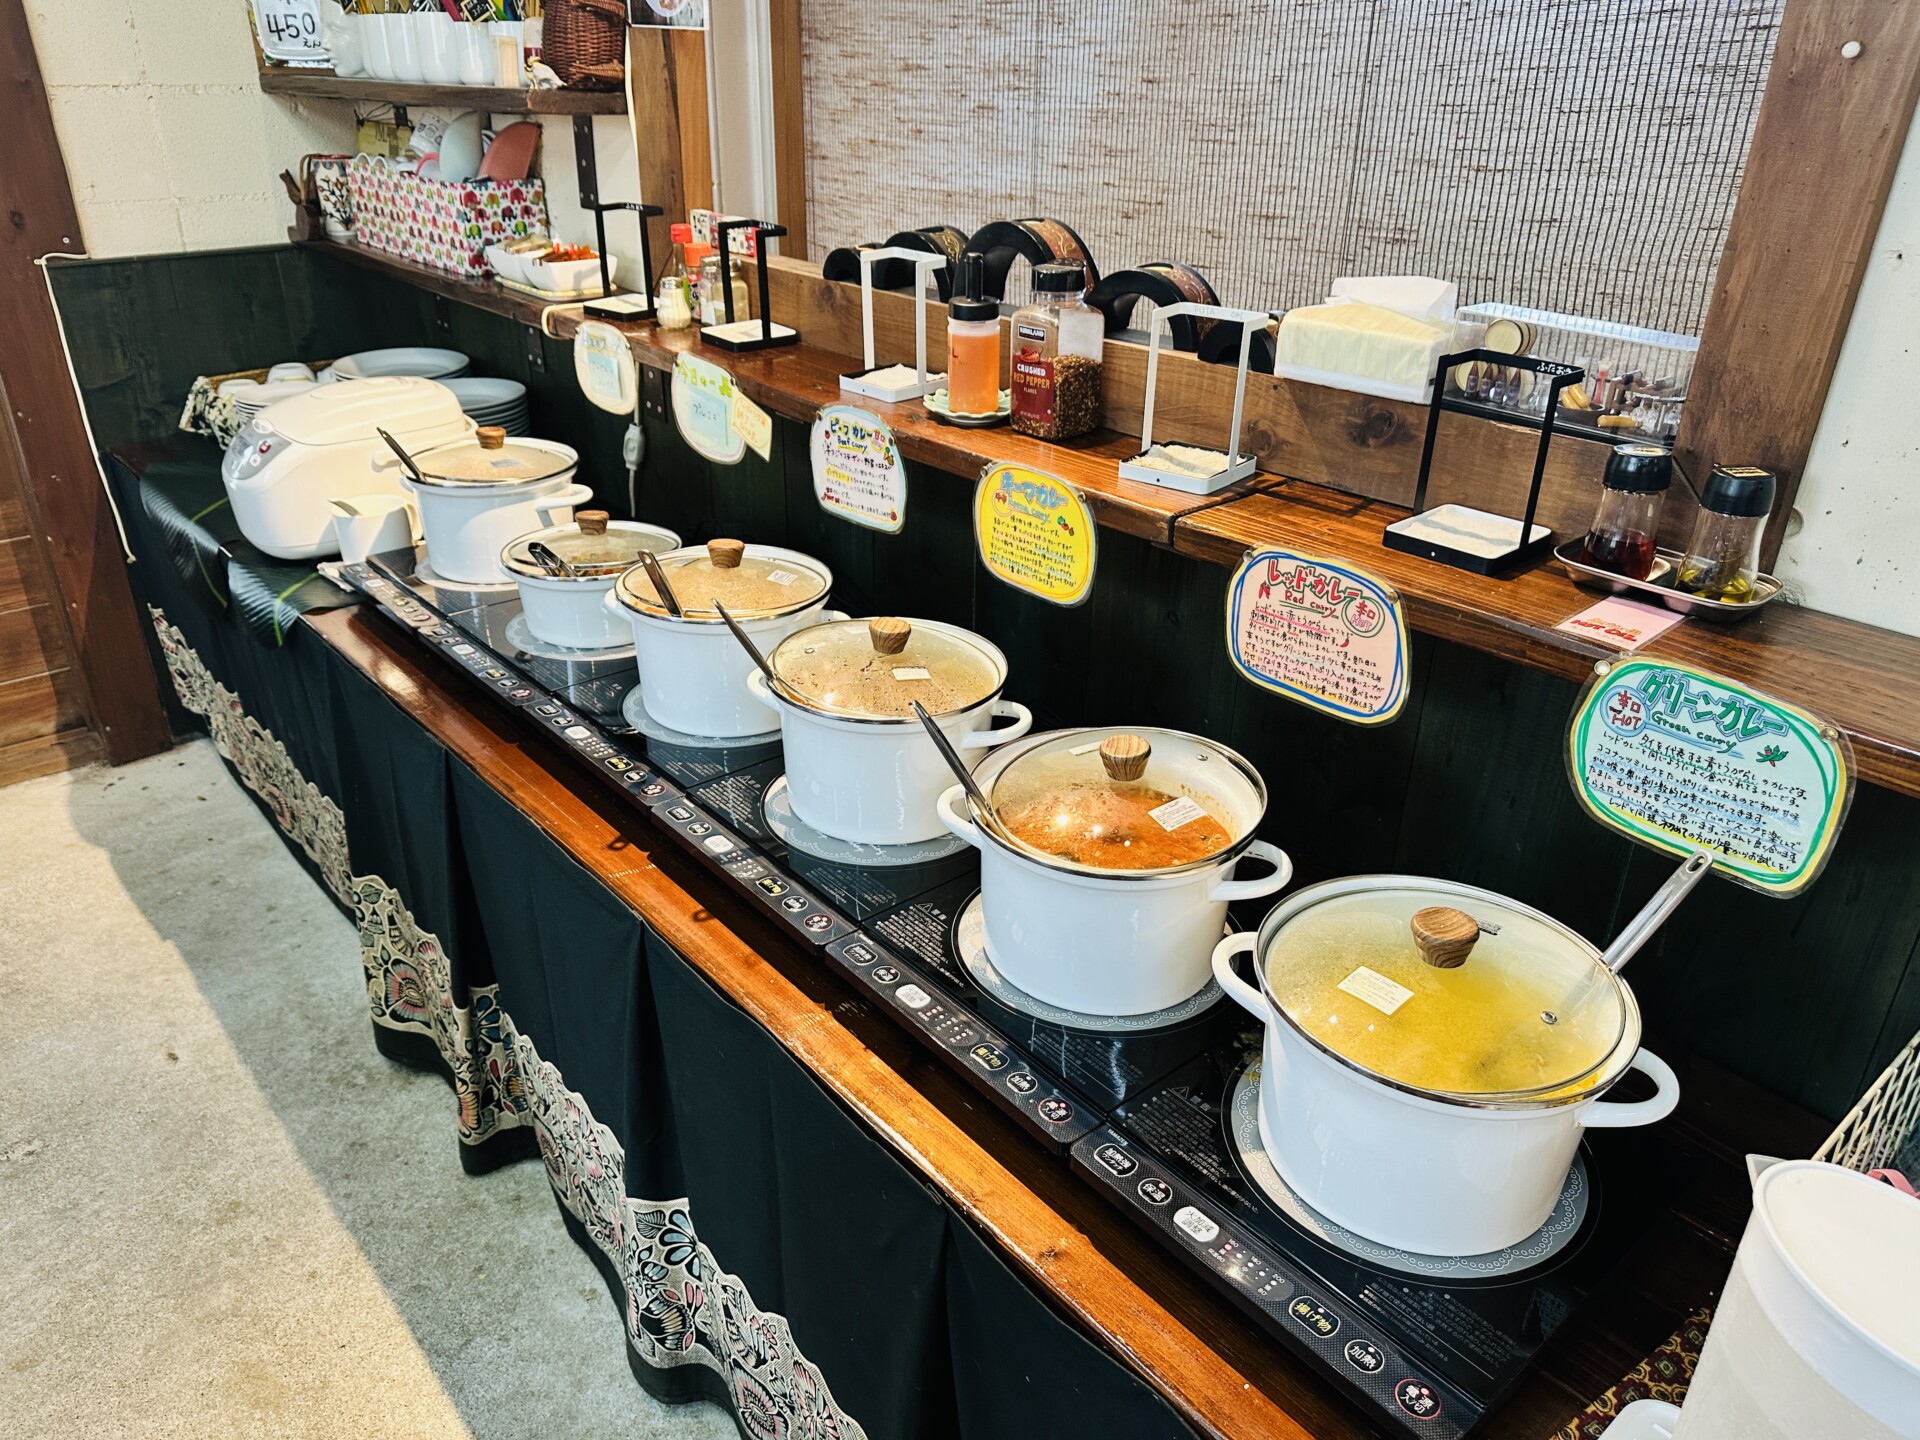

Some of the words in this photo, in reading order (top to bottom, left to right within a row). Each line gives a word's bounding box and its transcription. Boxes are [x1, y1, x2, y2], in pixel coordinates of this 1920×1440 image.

[266, 13, 315, 42] 450
[303, 38, 321, 49] えん
[1020, 327, 1044, 337] KIRKLAND
[1017, 364, 1046, 376] CRUSHED
[1014, 373, 1024, 383] RED
[1026, 376, 1050, 389] PEPPER
[838, 435, 850, 446] Beef
[1002, 471, 1068, 509] キーマカレー
[1268, 559, 1361, 603] レッドカレー
[1284, 590, 1305, 605] Red
[1310, 601, 1337, 618] curry
[1355, 601, 1376, 619] 辛口
[1350, 614, 1372, 631] HOT
[1617, 689, 1642, 714] 辛口
[1641, 670, 1788, 738] グリーンカレー
[1611, 713, 1641, 731] HOT
[1652, 711, 1691, 736] Green
[1143, 1183, 1165, 1202] 保温
[1186, 1211, 1214, 1233] 火加減
[1272, 1274, 1285, 1284] 200
[1294, 1302, 1332, 1332] 揚げ物
[1349, 1345, 1377, 1370] 加熱
[1400, 1394, 1425, 1414] 入/切
[1405, 1385, 1435, 1410] 電源
